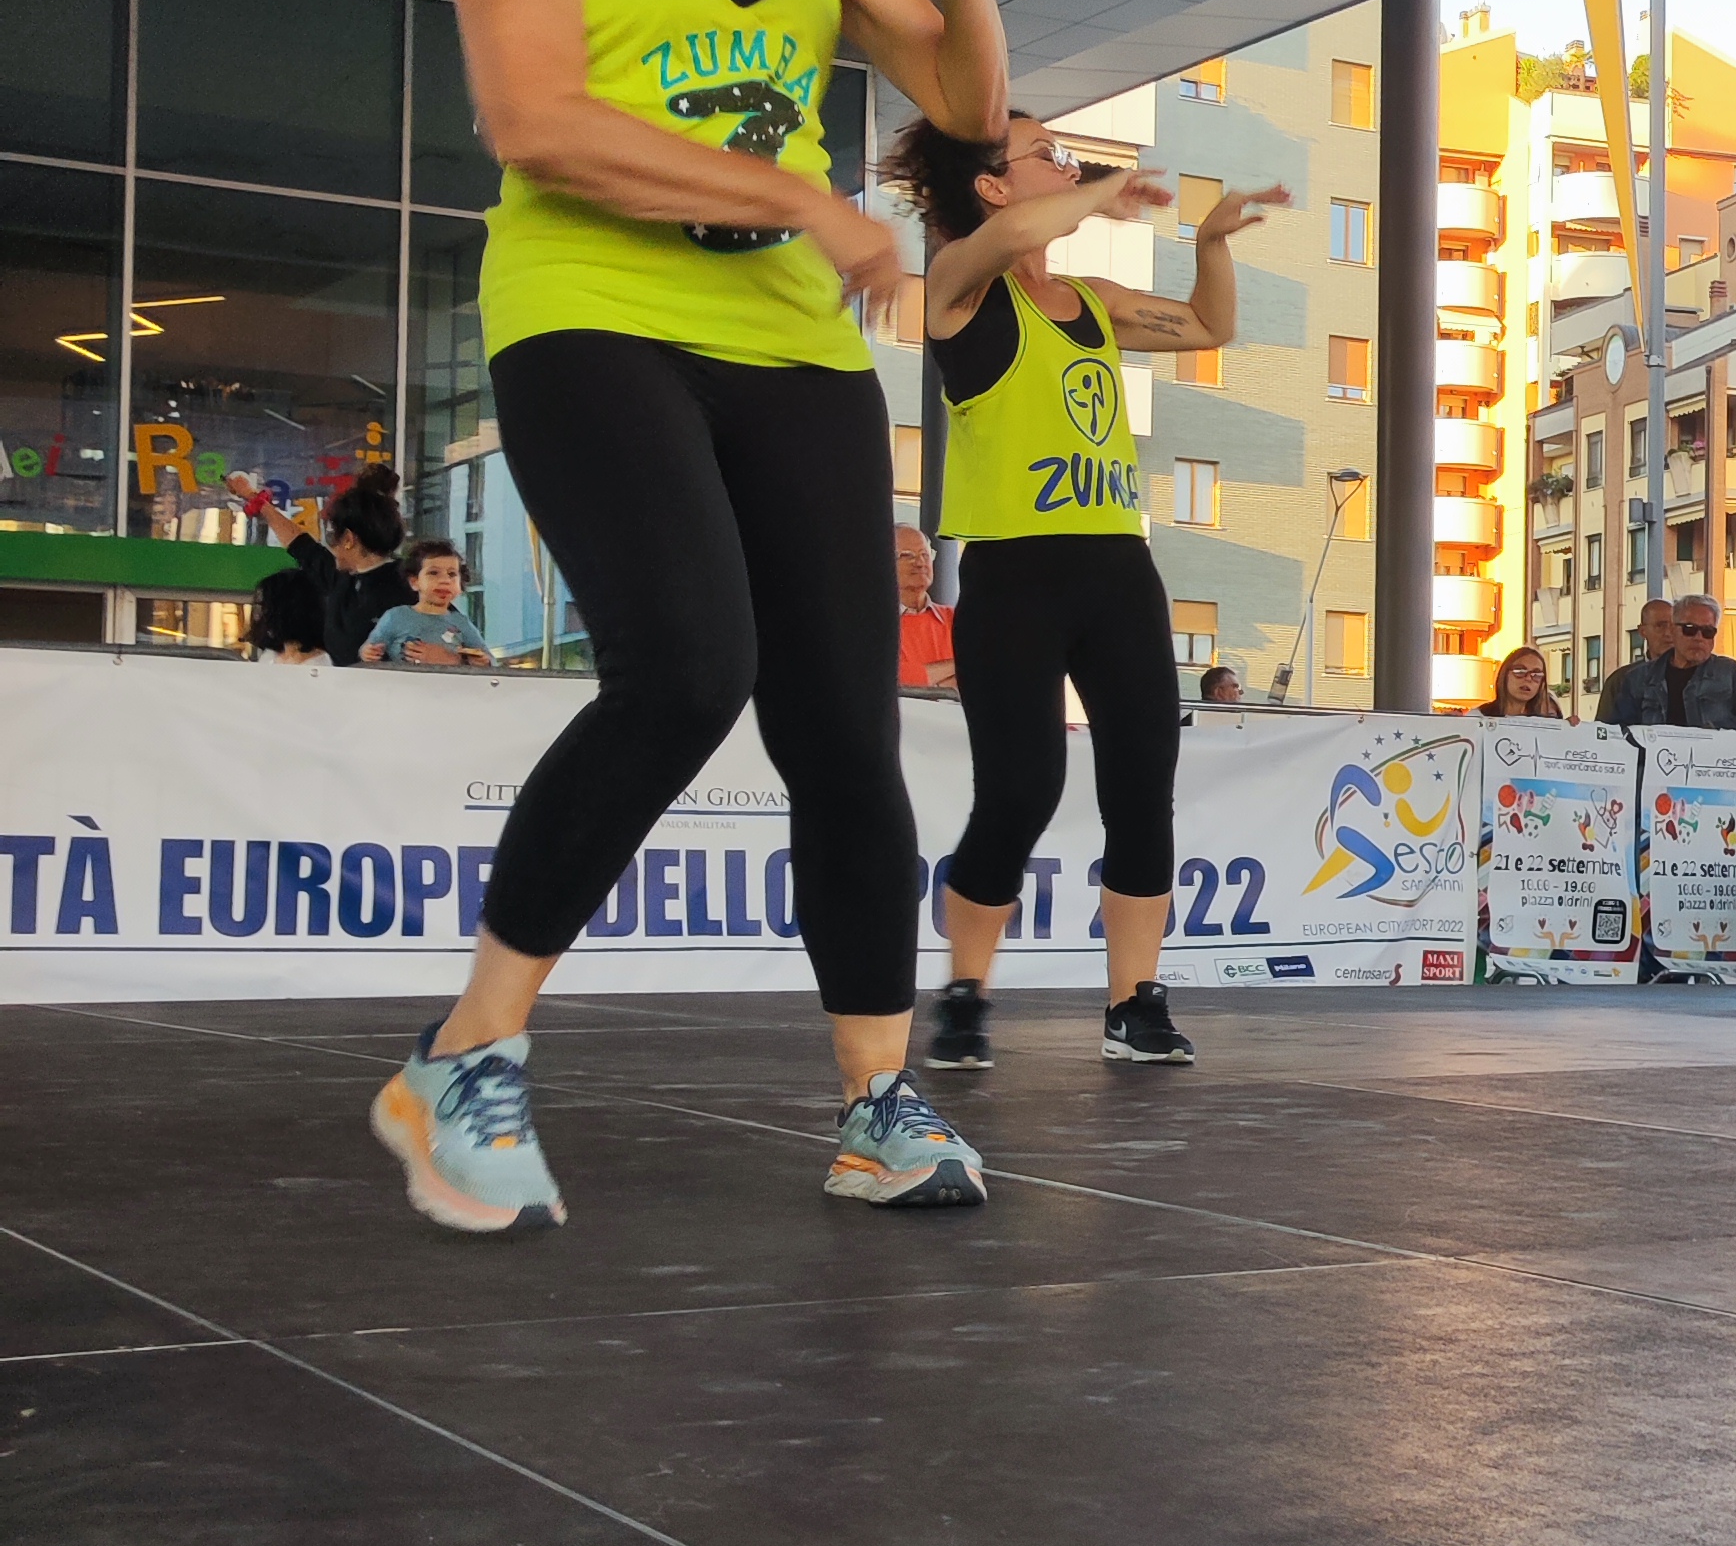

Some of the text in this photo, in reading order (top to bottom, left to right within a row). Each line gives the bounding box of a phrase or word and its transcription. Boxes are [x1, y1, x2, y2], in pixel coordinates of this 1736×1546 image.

[467, 781, 523, 800] CITT
[707, 788, 792, 807] GIOVAN
[1494, 854, 1622, 876] 21 e 22 settembre
[1653, 860, 1666, 877] 21
[1671, 861, 1678, 877] e
[1681, 860, 1696, 877] 22
[159, 838, 498, 937] EUROPE
[1303, 922, 1373, 936] EUROPEAN
[1437, 919, 1464, 933] 2022
[1427, 954, 1458, 964] MAXI
[1237, 964, 1266, 973] BCC
[1423, 967, 1461, 978] SPORT
